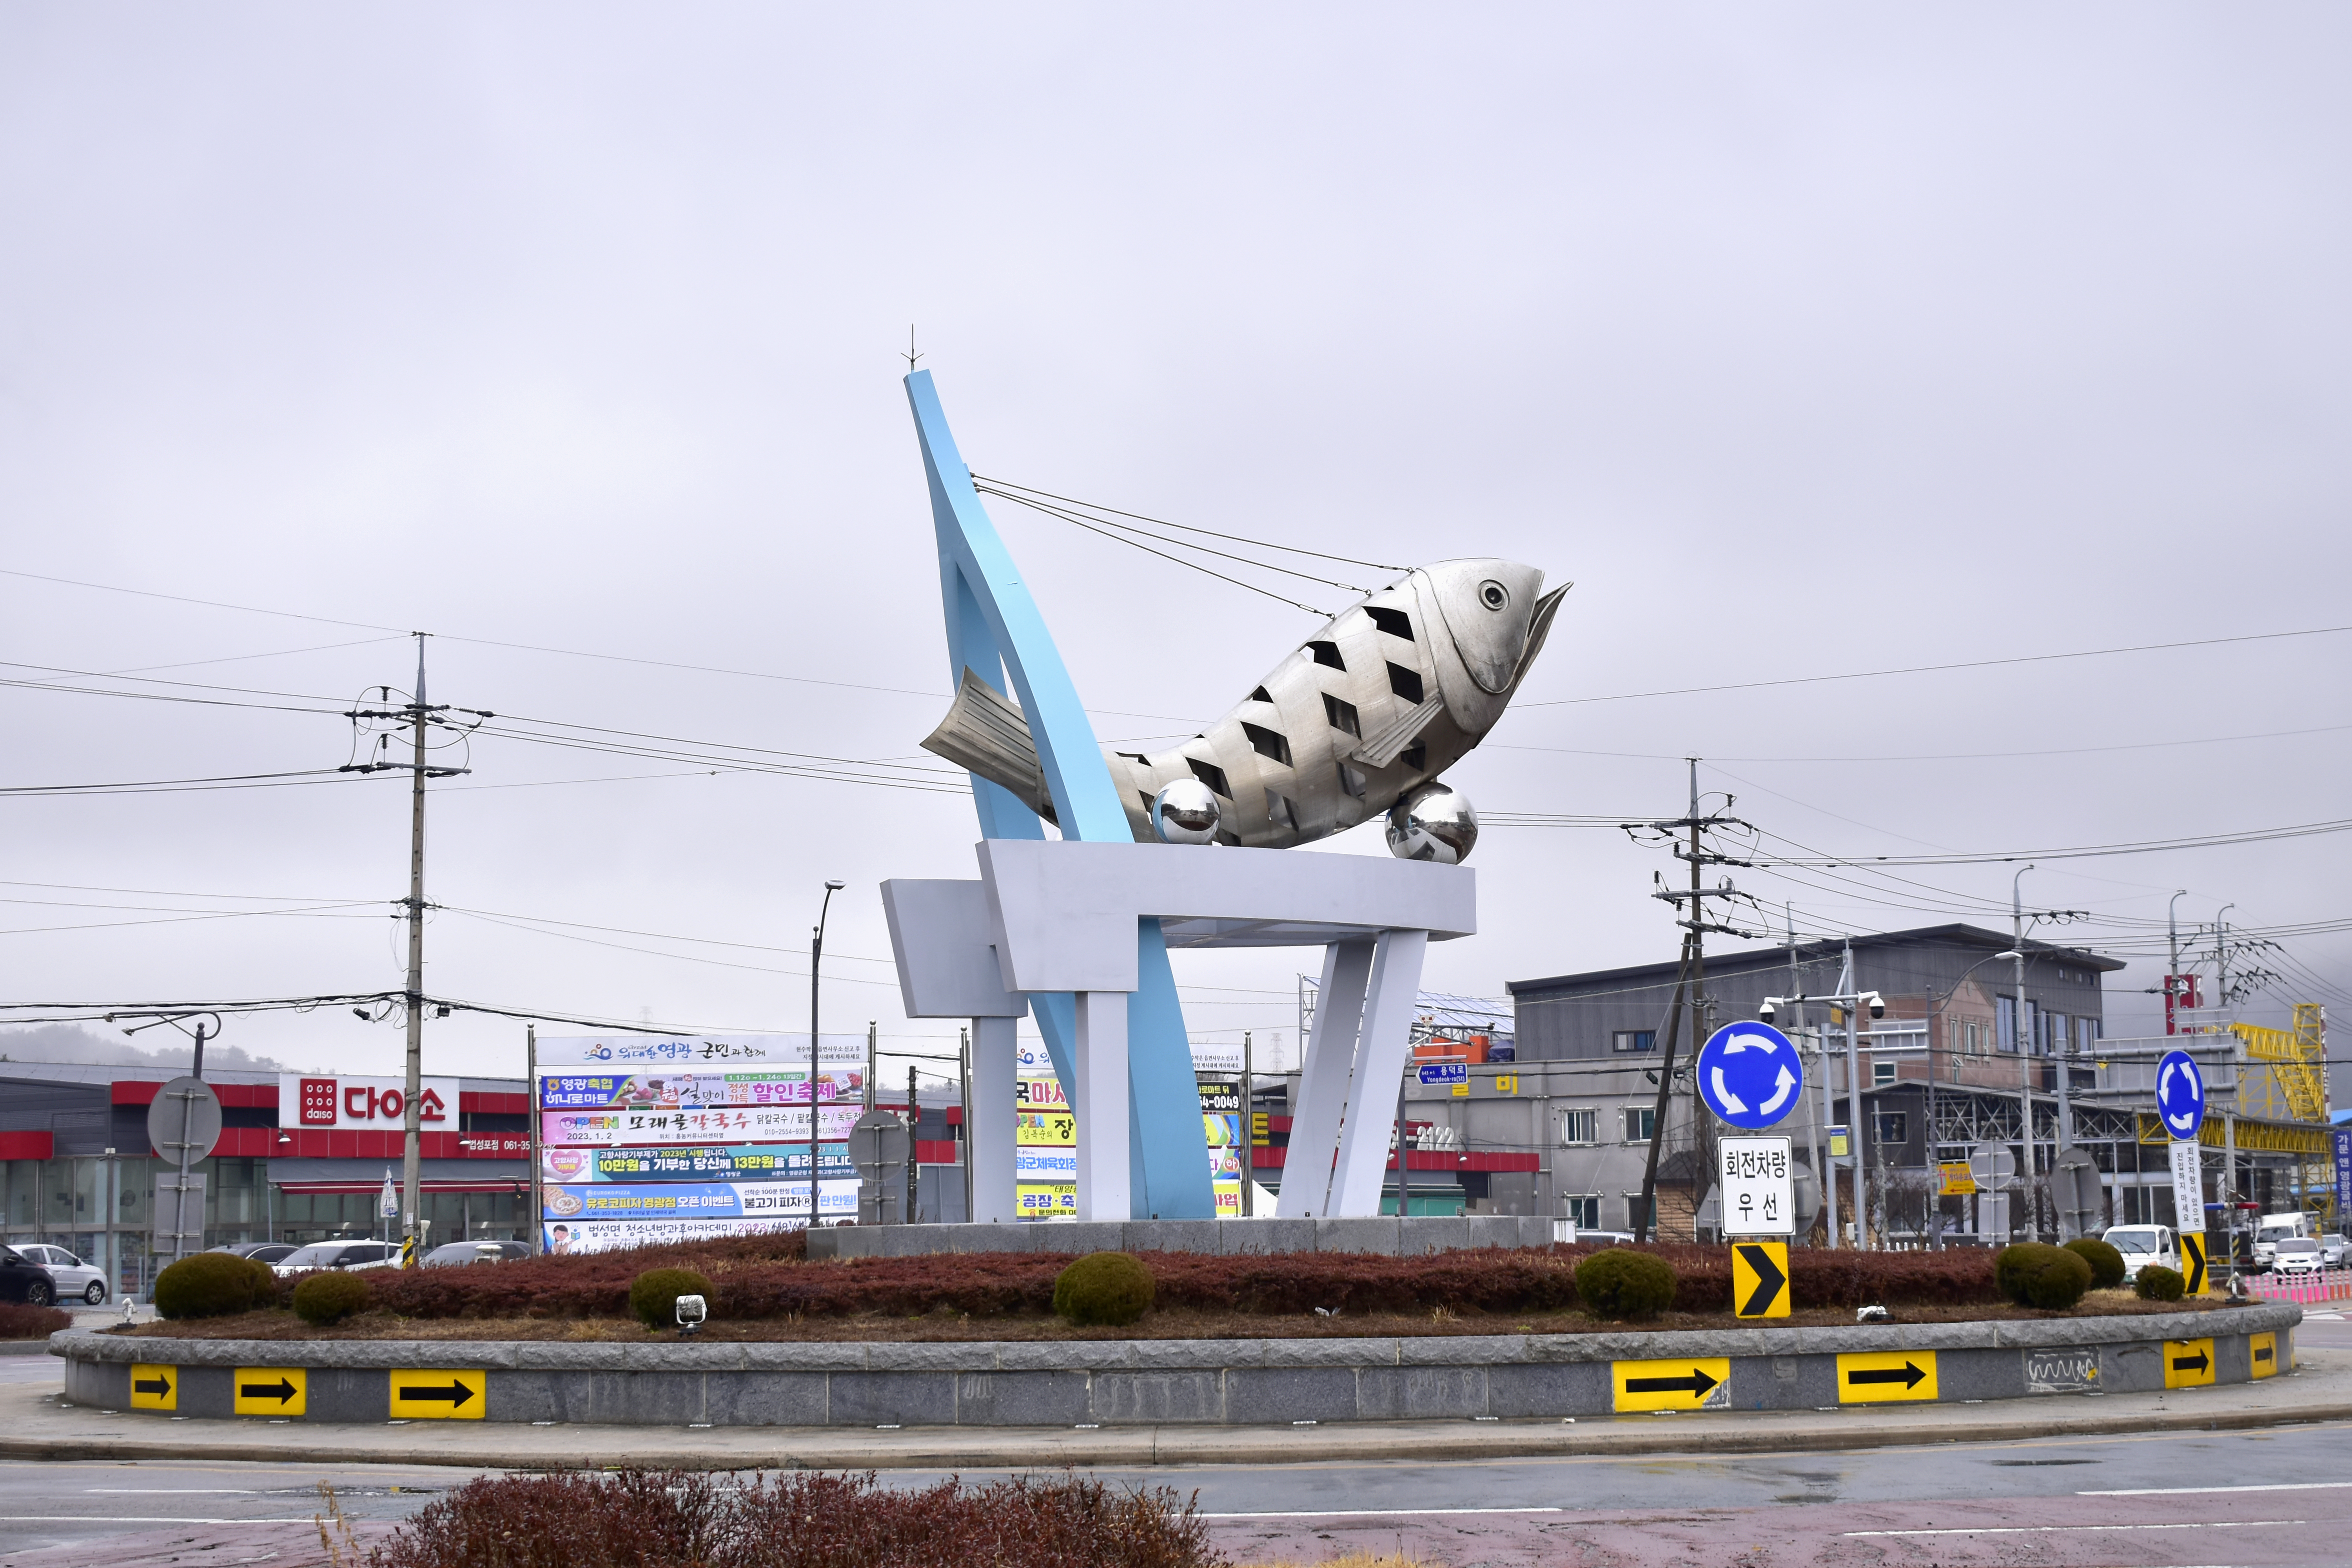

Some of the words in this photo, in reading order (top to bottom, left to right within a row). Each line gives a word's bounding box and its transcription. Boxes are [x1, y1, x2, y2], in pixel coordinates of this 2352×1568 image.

[618, 1045, 658, 1059] 위대한
[658, 1042, 692, 1058] 영광
[696, 1041, 742, 1058] 군민과
[744, 1045, 766, 1057] 함께
[1441, 1066, 1465, 1076] 용덕로
[561, 1078, 613, 1091] 영광축협
[728, 1083, 748, 1093] 정성
[1222, 1085, 1229, 1094] 뒤
[546, 1091, 608, 1104] 하나로마트
[728, 1094, 748, 1103] 가득
[752, 1083, 793, 1102] 할인
[797, 1082, 835, 1101] 축제
[345, 1087, 446, 1121] 다이소
[307, 1108, 333, 1119] daiso
[837, 1112, 861, 1122] 녹두전
[560, 1116, 619, 1130] OPEN
[470, 1140, 499, 1150] 법성포점
[504, 1141, 556, 1150] 061-35-2292
[2338, 1134, 2349, 1154] 가문
[599, 1151, 658, 1159] 고향사랑기부제가
[689, 1149, 728, 1157] 시행됩니다.
[599, 1159, 650, 1171] 10만원을
[653, 1158, 690, 1171] 기부한
[693, 1157, 731, 1170] 당신께
[734, 1156, 785, 1169] 13만원을
[1726, 1149, 1786, 1179] 회전차량
[2187, 1146, 2197, 1194] 회전차량이
[2177, 1152, 2186, 1190] 진입하지
[586, 1197, 642, 1209] 유로코피자
[643, 1197, 677, 1209] 영광점
[677, 1196, 701, 1207] 오픈
[701, 1196, 735, 1207] 이벤트
[744, 1197, 777, 1208] 불고기
[832, 1194, 857, 1206] 만원!
[2181, 1194, 2189, 1221] 마세요
[2191, 1198, 2200, 1226] 있으면
[588, 1223, 621, 1237] 법성면
